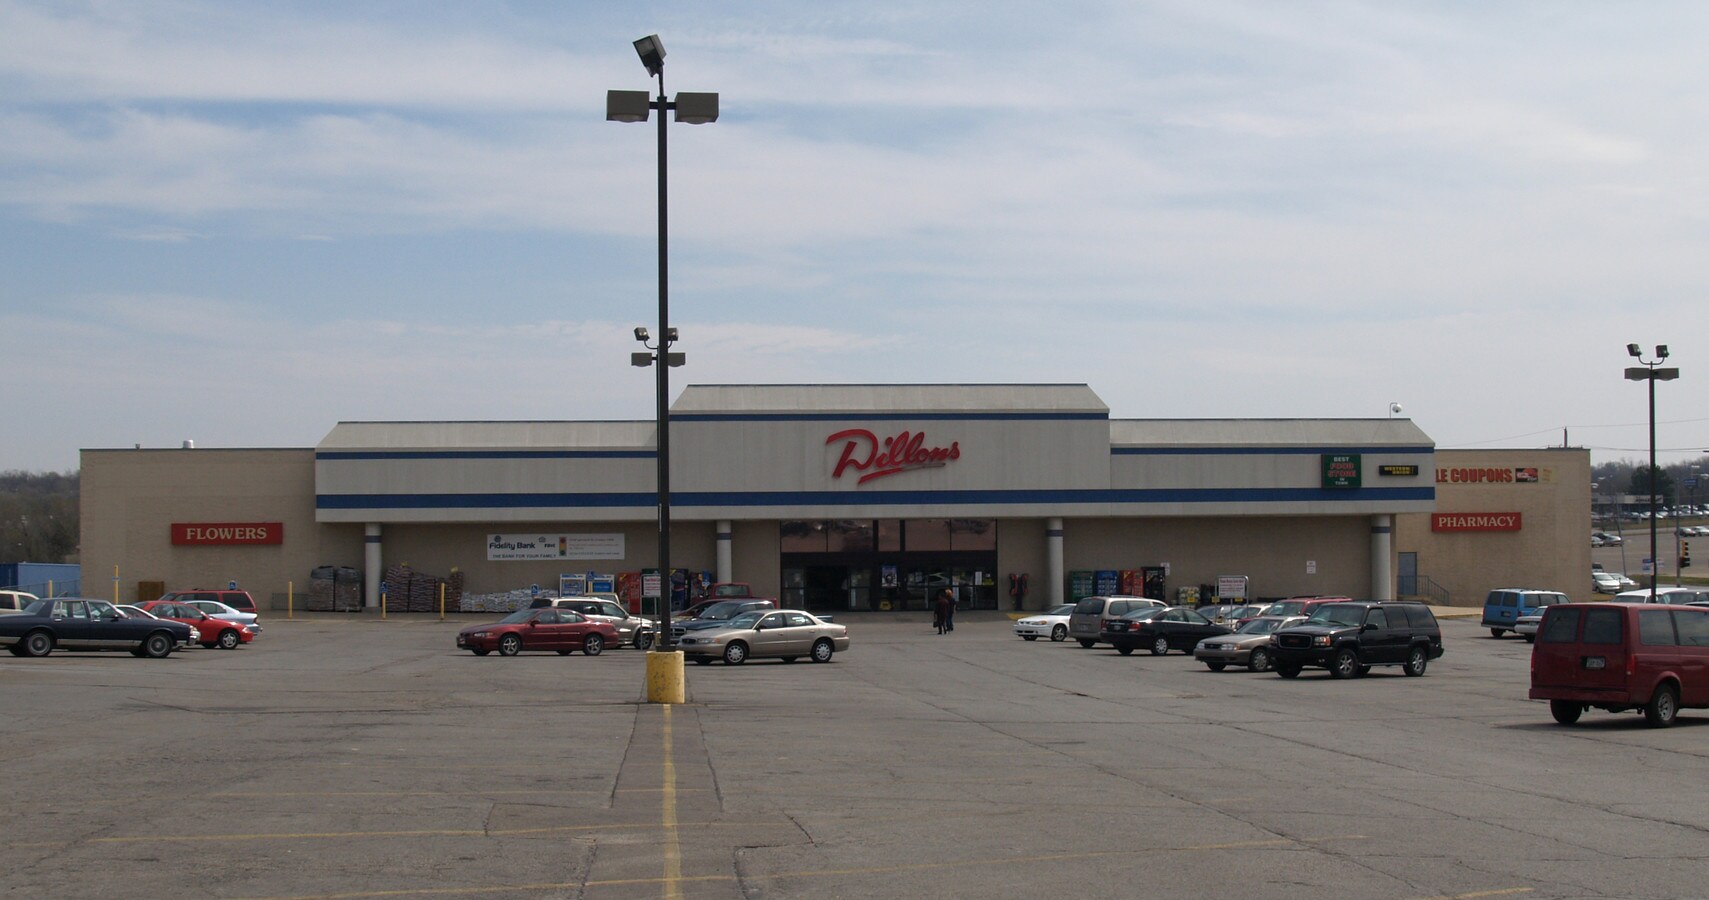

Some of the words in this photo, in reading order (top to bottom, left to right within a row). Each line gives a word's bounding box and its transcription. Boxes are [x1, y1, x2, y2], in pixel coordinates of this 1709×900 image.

[825, 428, 961, 479] Dillons
[1450, 468, 1513, 483] COUPONS
[1438, 516, 1516, 528] PHARMACY
[186, 527, 267, 540] FLOWERS
[489, 542, 515, 551] Fidelity
